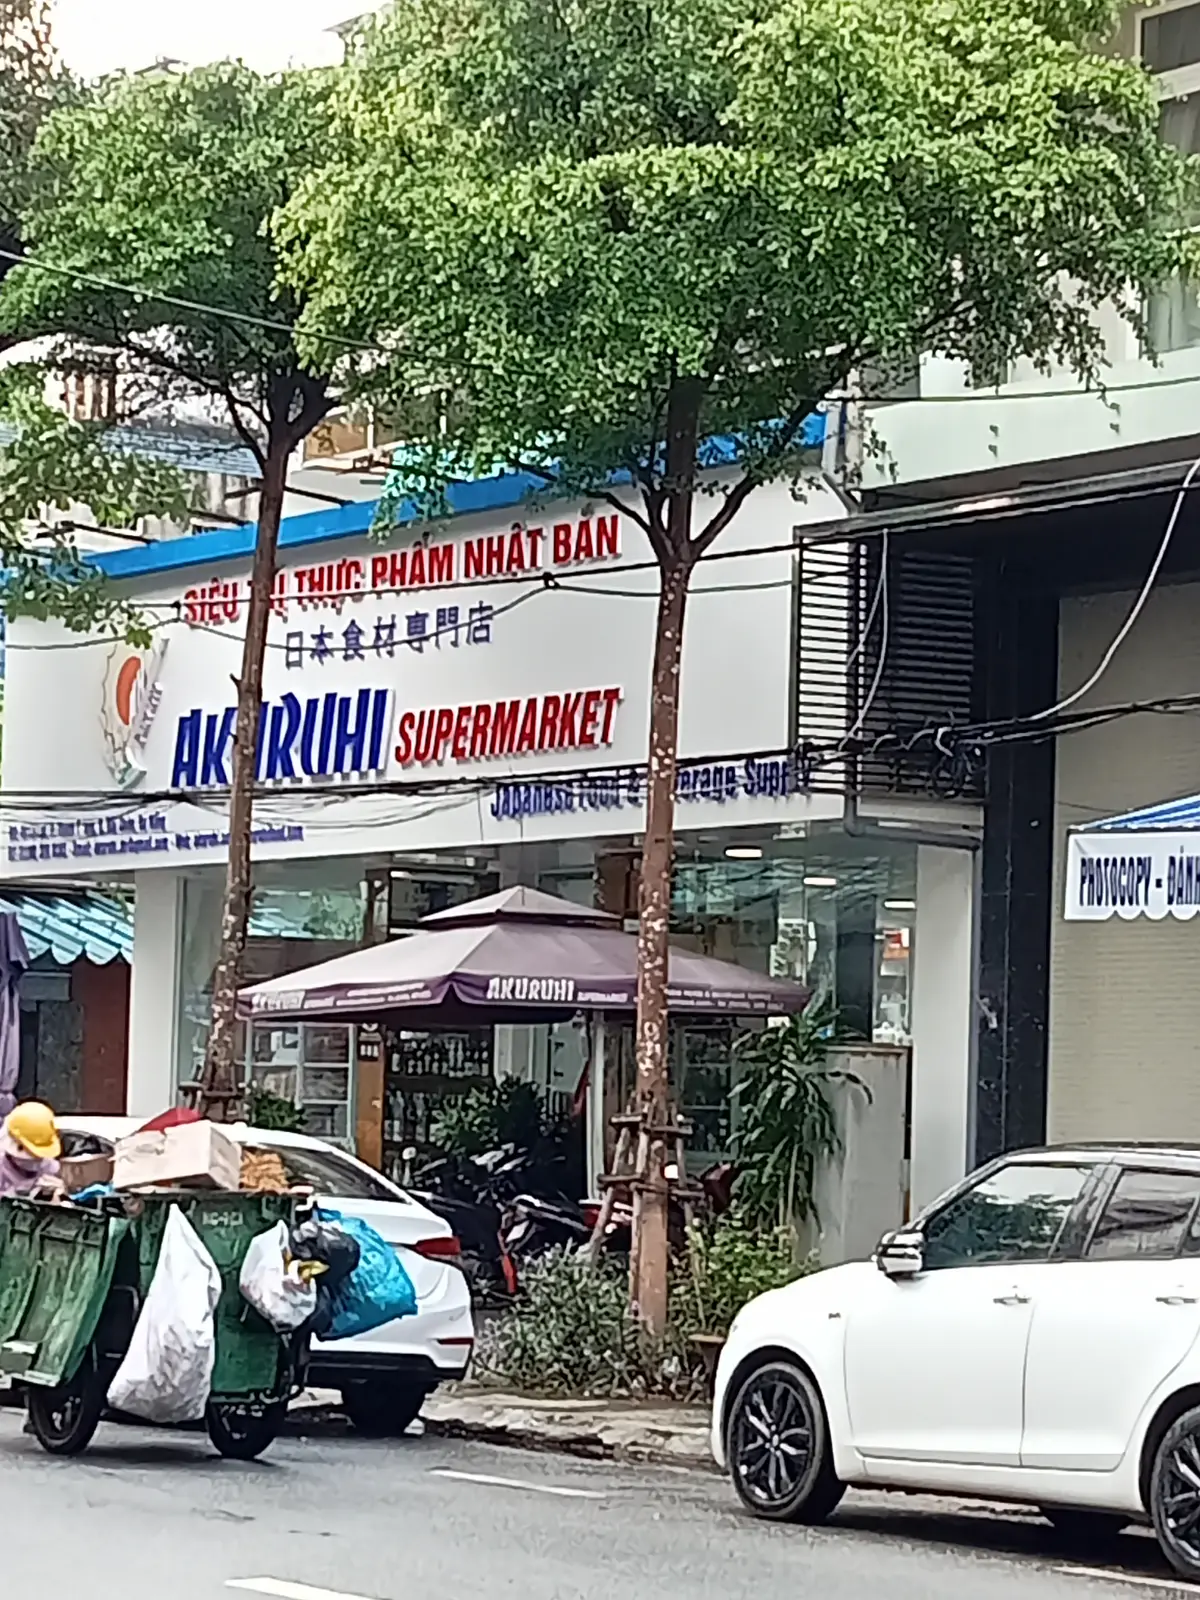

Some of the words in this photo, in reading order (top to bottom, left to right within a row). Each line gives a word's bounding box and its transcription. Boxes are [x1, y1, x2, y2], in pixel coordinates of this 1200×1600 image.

[184, 577, 239, 624] SIÊU
[371, 531, 454, 588] PHẨM
[464, 522, 543, 578] NHẬT
[553, 503, 619, 564] BẢN
[395, 687, 621, 762] SUPERMARKET
[1079, 857, 1152, 906] PHOTOCOPY
[486, 977, 575, 1001] AKURUHI
